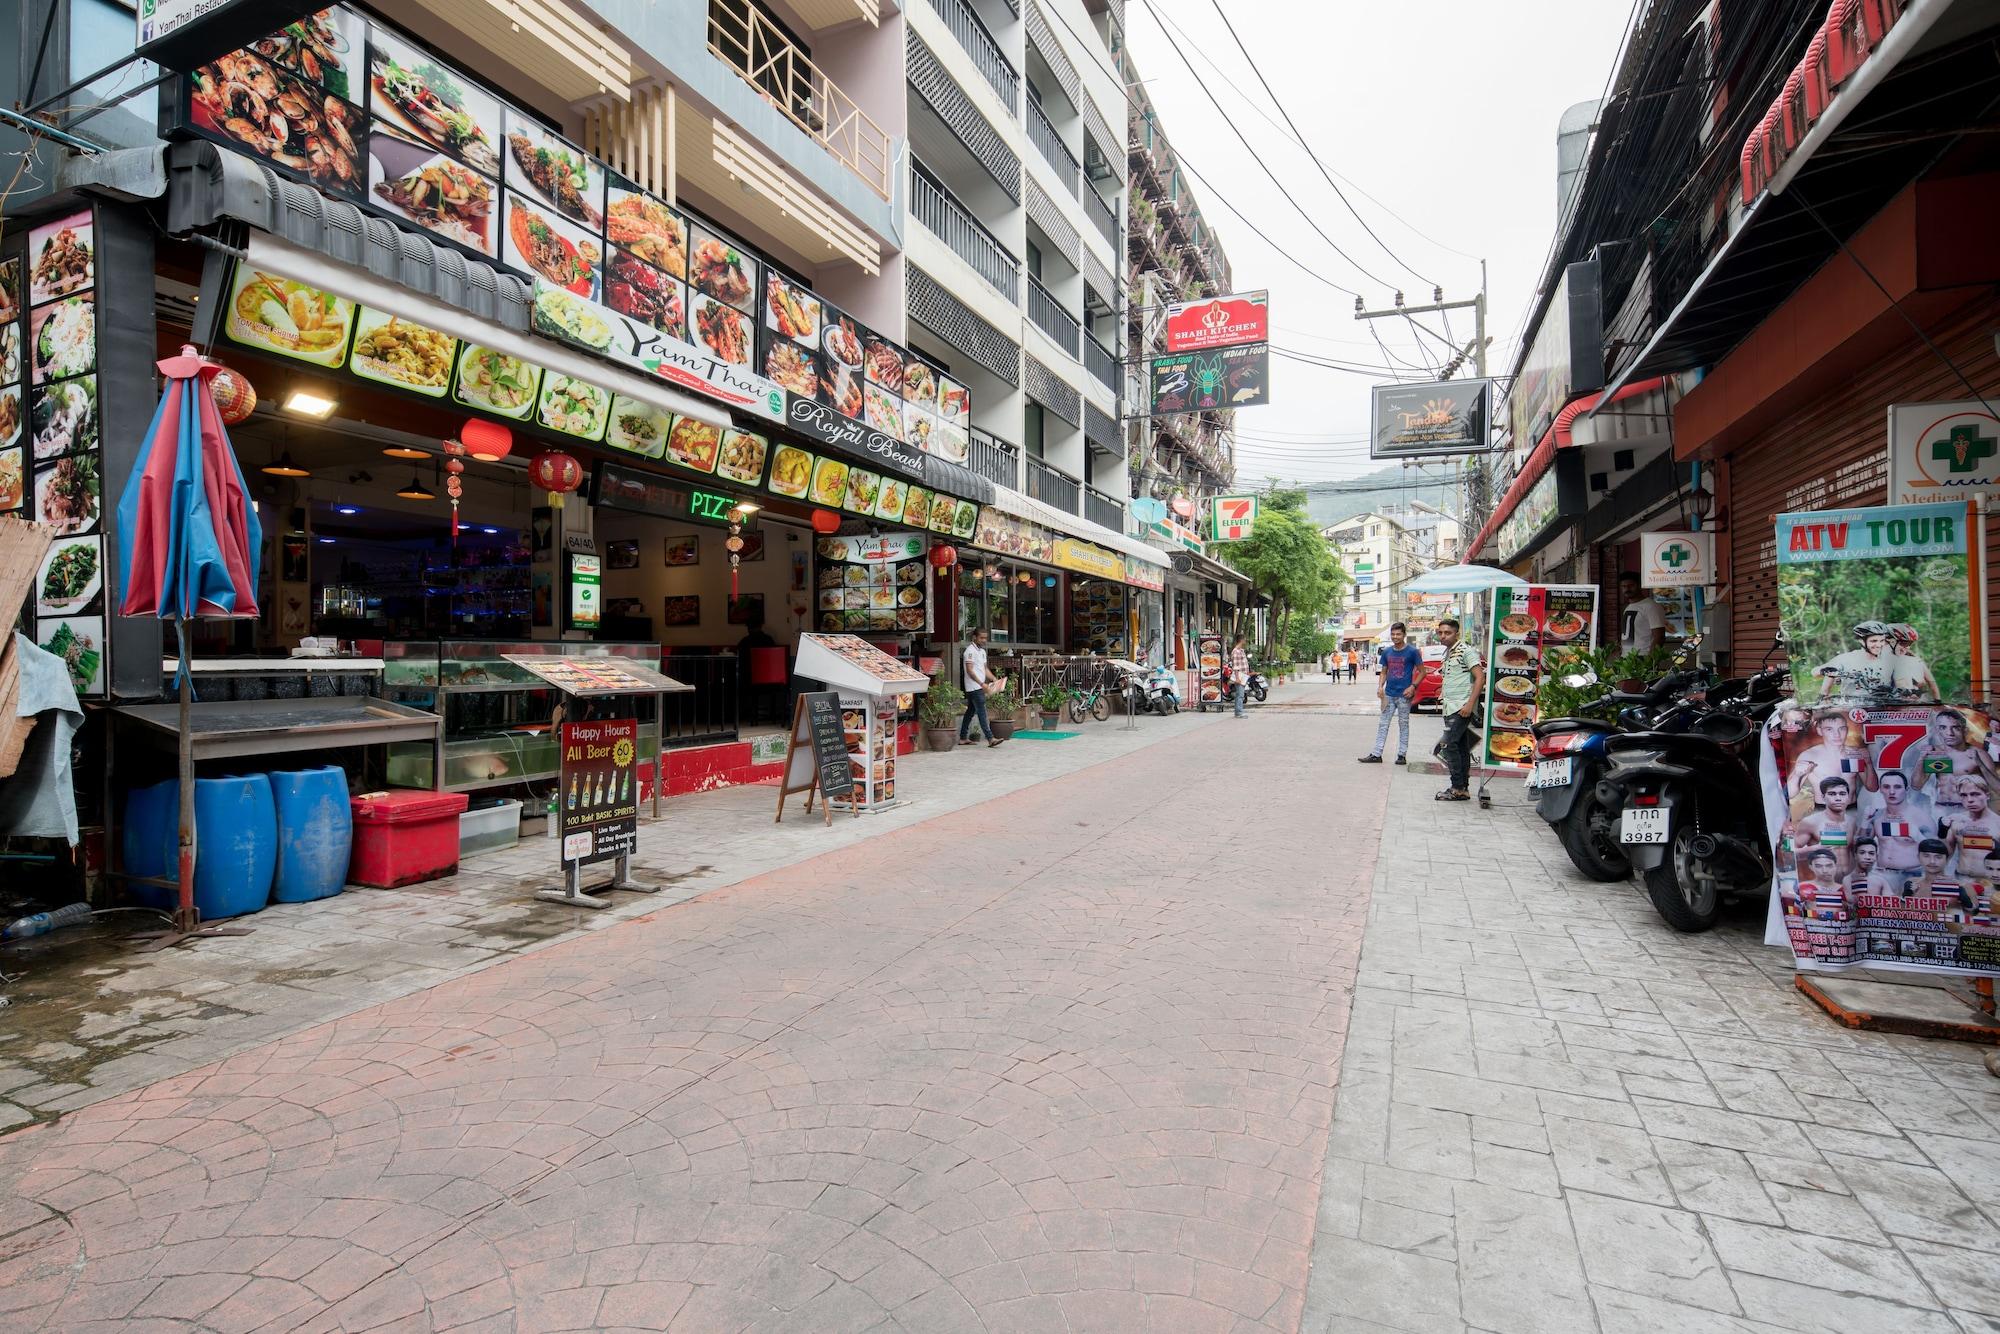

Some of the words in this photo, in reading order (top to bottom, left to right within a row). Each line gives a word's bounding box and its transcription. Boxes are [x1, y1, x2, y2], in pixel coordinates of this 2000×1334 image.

[159, 9, 192, 35] YamThai
[237, 317, 252, 328] TOM
[1174, 329, 1208, 340] SHAHI
[1209, 322, 1258, 336] KITCHEN
[1223, 349, 1248, 358] INDIAN
[1249, 345, 1267, 355] FOOD
[1153, 357, 1176, 367] ARABIC
[1177, 354, 1193, 364] FOOD
[1157, 365, 1171, 375] THAI
[1171, 363, 1188, 374] FOOD
[1397, 409, 1455, 431] Tandoor
[790, 399, 865, 446] Royal
[866, 432, 924, 471] Beach
[1902, 491, 1965, 505] Medical
[1222, 500, 1250, 539] 7
[1789, 522, 1849, 553] ATV
[1866, 516, 1954, 547] TOUR
[568, 535, 595, 550] 64/40
[1070, 546, 1089, 561] SHAHI
[1648, 574, 1677, 583] Medical
[1680, 574, 1704, 583] Center
[1501, 591, 1541, 602] Pizza
[1498, 668, 1529, 676] PASTA
[571, 726, 601, 741] Happy
[605, 723, 631, 737] Hours
[567, 746, 582, 761] All
[587, 745, 611, 759] Beer
[617, 743, 630, 756] 60
[1864, 724, 1928, 770] 7
[1540, 776, 1568, 788] 2288
[567, 816, 580, 826] 100
[596, 810, 613, 820] BASIC
[614, 806, 635, 816] SPIRITS
[615, 831, 636, 841] Breakfast
[1625, 832, 1663, 843] 3987
[1857, 896, 1901, 909] SUPER
[1903, 897, 1949, 912] FIGHT
[1871, 908, 1933, 921] MUAYTHAI
[1859, 918, 1948, 931] INTERNATIONAL
[1808, 932, 1828, 945] FREE
[1891, 933, 1916, 941] STADIUM
